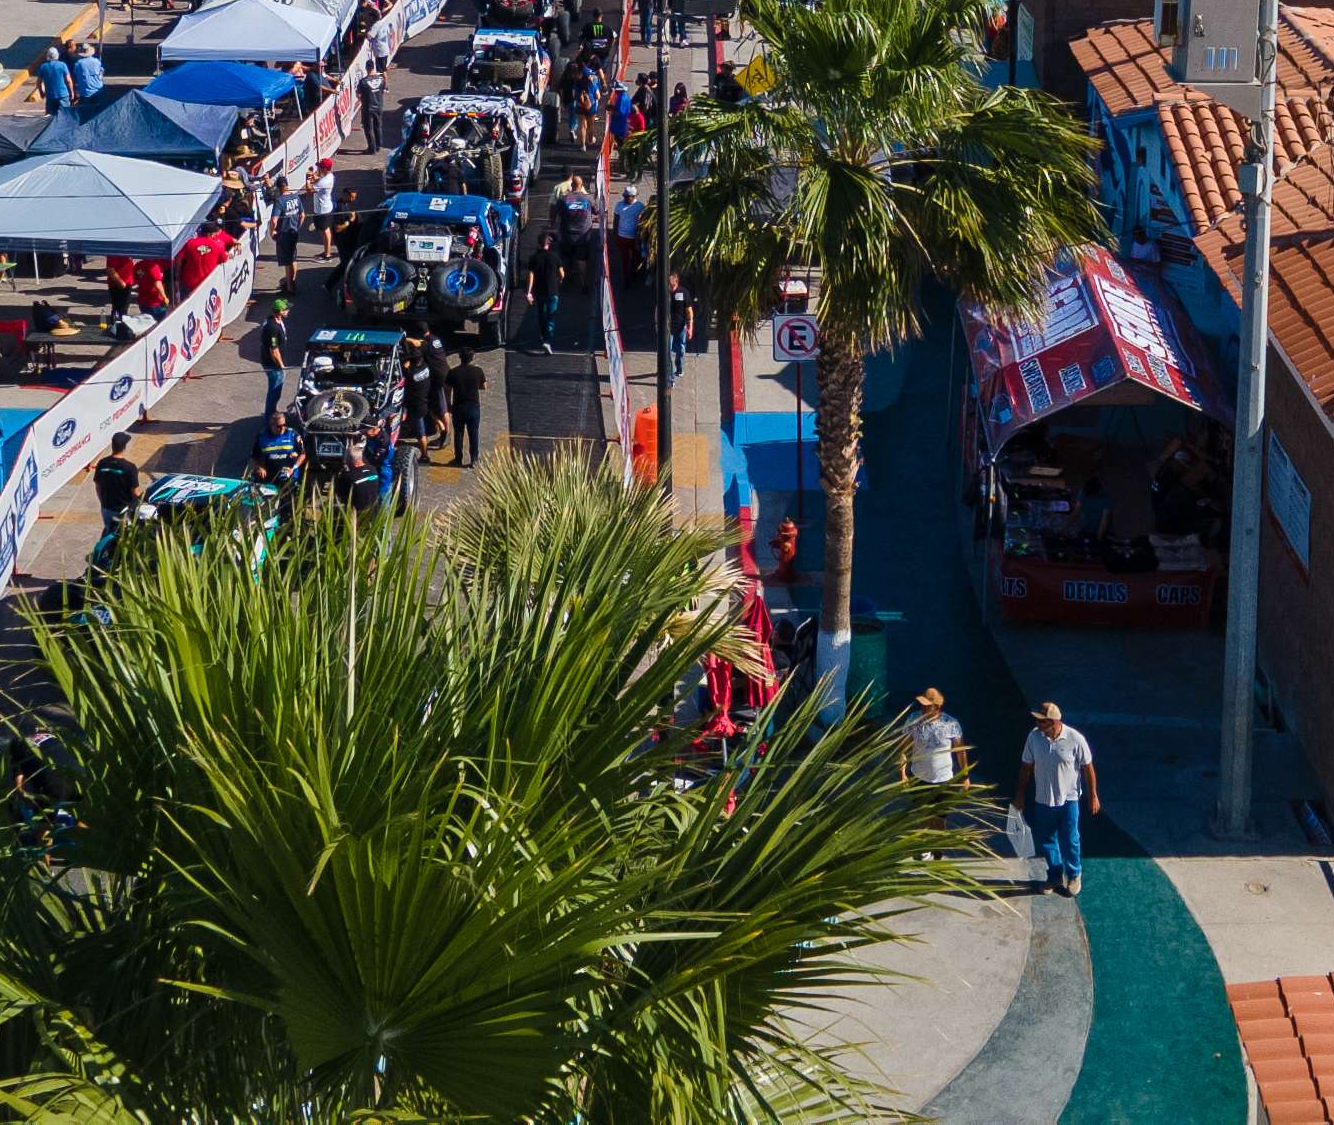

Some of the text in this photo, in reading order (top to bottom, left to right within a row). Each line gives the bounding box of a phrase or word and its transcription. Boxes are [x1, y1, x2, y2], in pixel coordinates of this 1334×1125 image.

[788, 325, 807, 350] E
[1064, 581, 1128, 603] DECALS
[1157, 585, 1201, 604] CAPS
